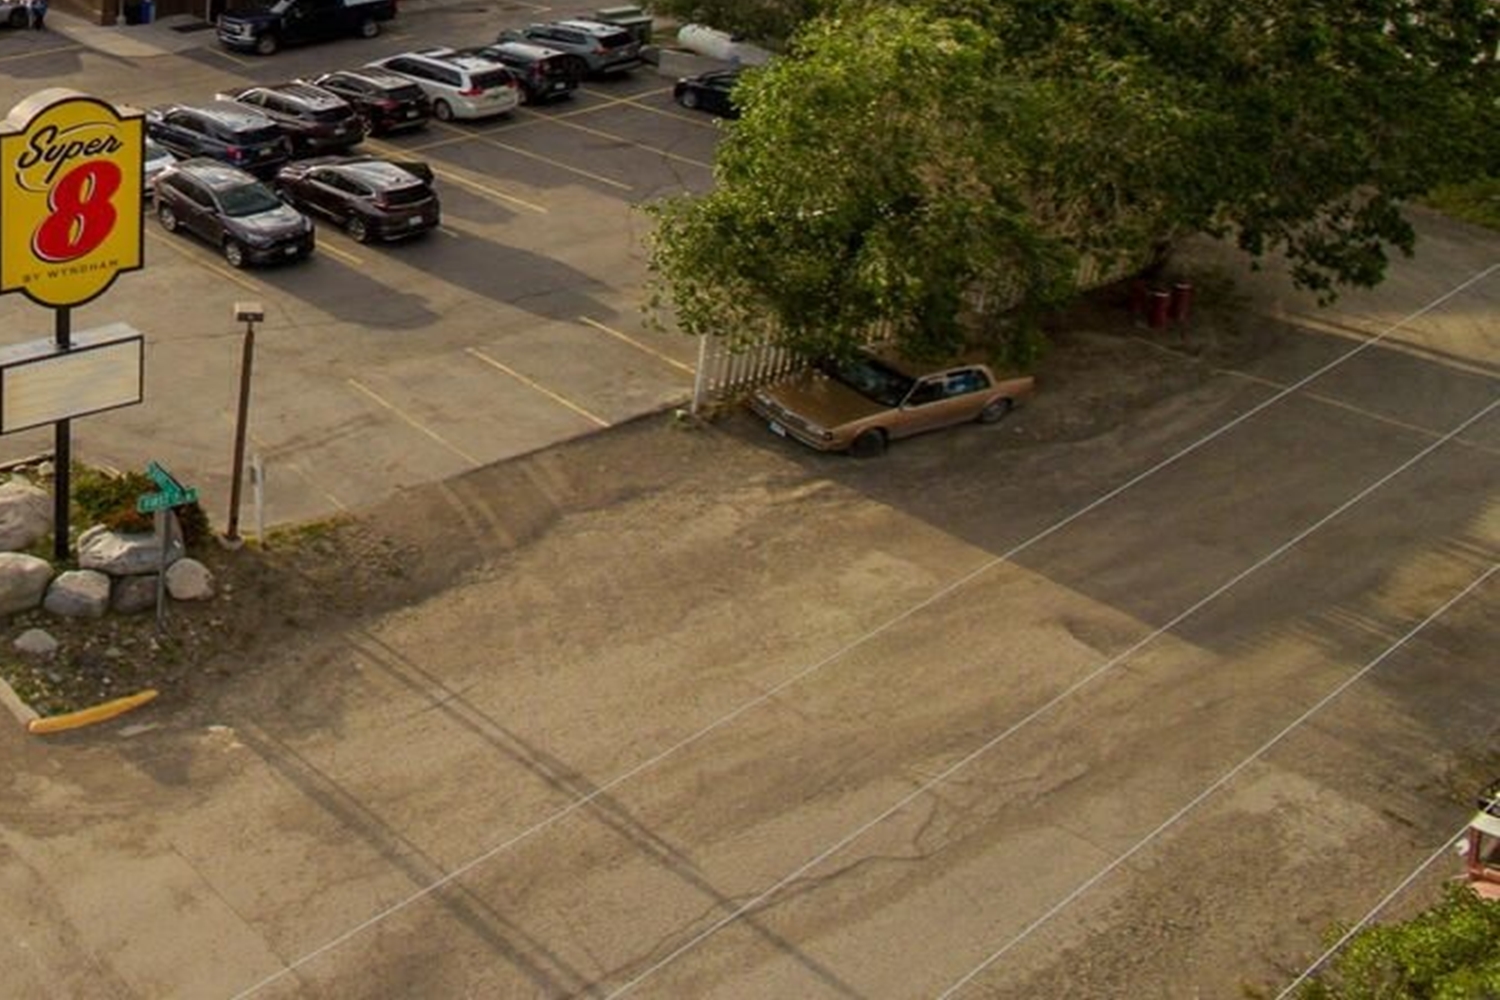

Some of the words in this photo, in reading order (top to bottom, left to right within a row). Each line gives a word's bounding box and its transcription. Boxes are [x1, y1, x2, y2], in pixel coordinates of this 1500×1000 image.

[17, 124, 124, 184] Super
[30, 159, 122, 263] 8
[23, 272, 40, 283] BY
[47, 260, 118, 279] WYNDHAM
